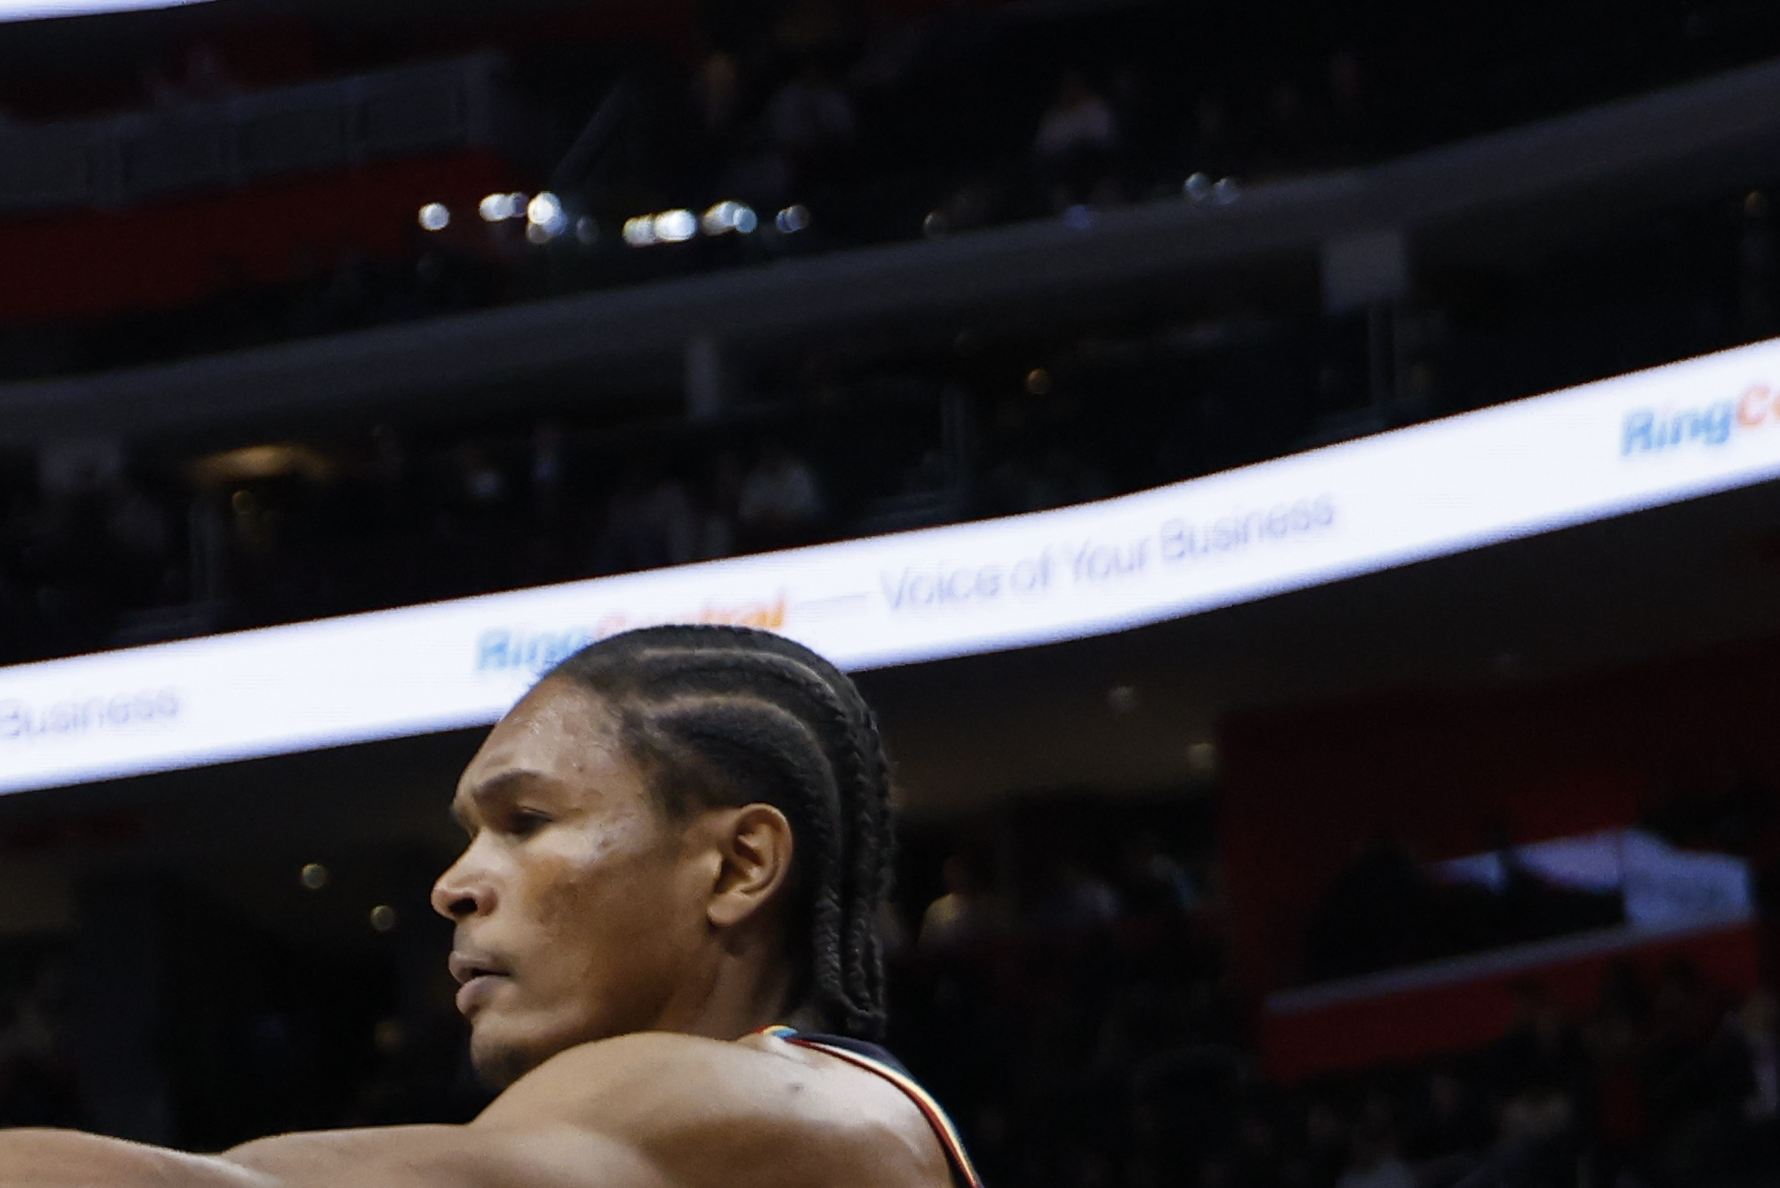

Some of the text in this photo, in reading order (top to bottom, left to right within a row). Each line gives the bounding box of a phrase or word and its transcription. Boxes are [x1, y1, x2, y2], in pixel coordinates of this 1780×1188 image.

[880, 561, 1002, 612] Voice
[1010, 545, 1054, 594] of
[1061, 539, 1150, 584] Your
[1159, 495, 1339, 565] Business
